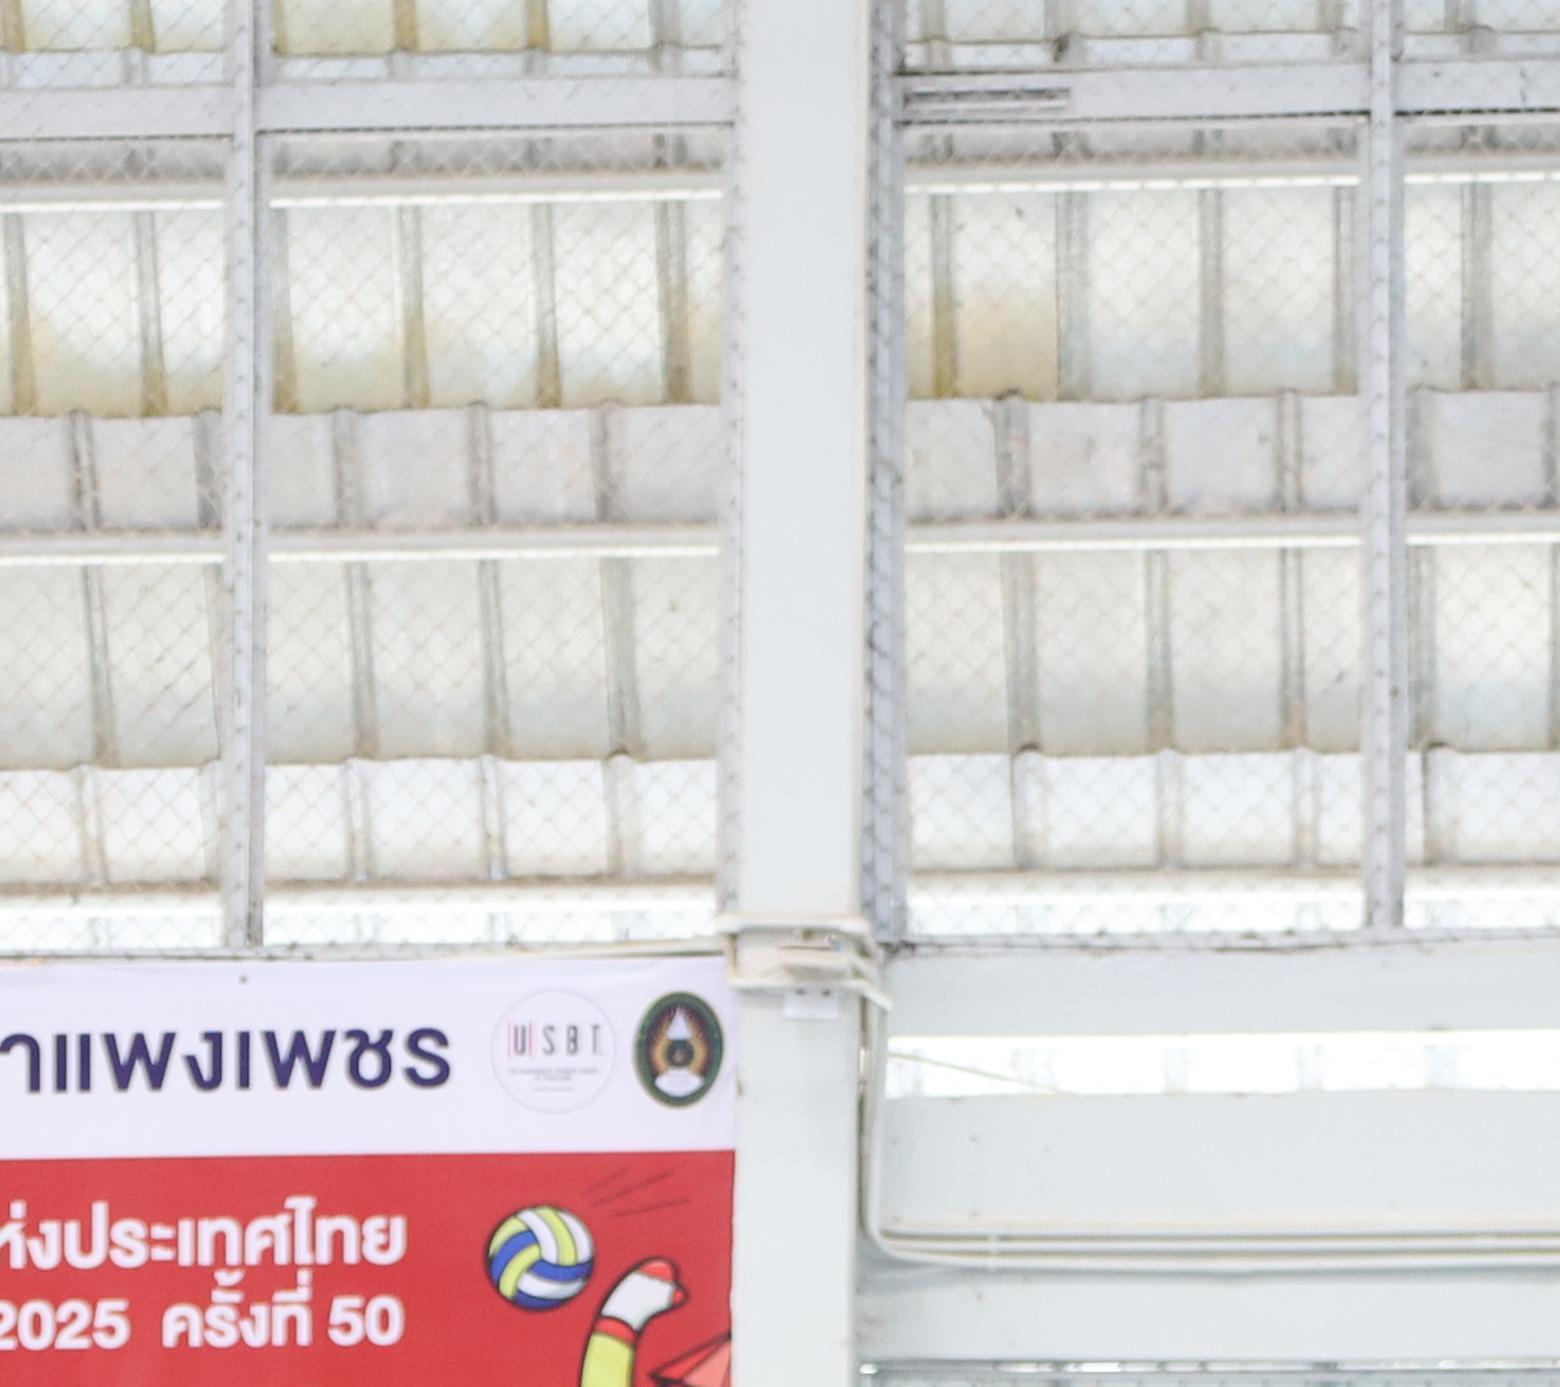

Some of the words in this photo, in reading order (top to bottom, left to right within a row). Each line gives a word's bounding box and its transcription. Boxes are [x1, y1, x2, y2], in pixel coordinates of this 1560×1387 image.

[162, 1269, 312, 1348] ครั้งที่
[328, 1296, 403, 1346] 50
